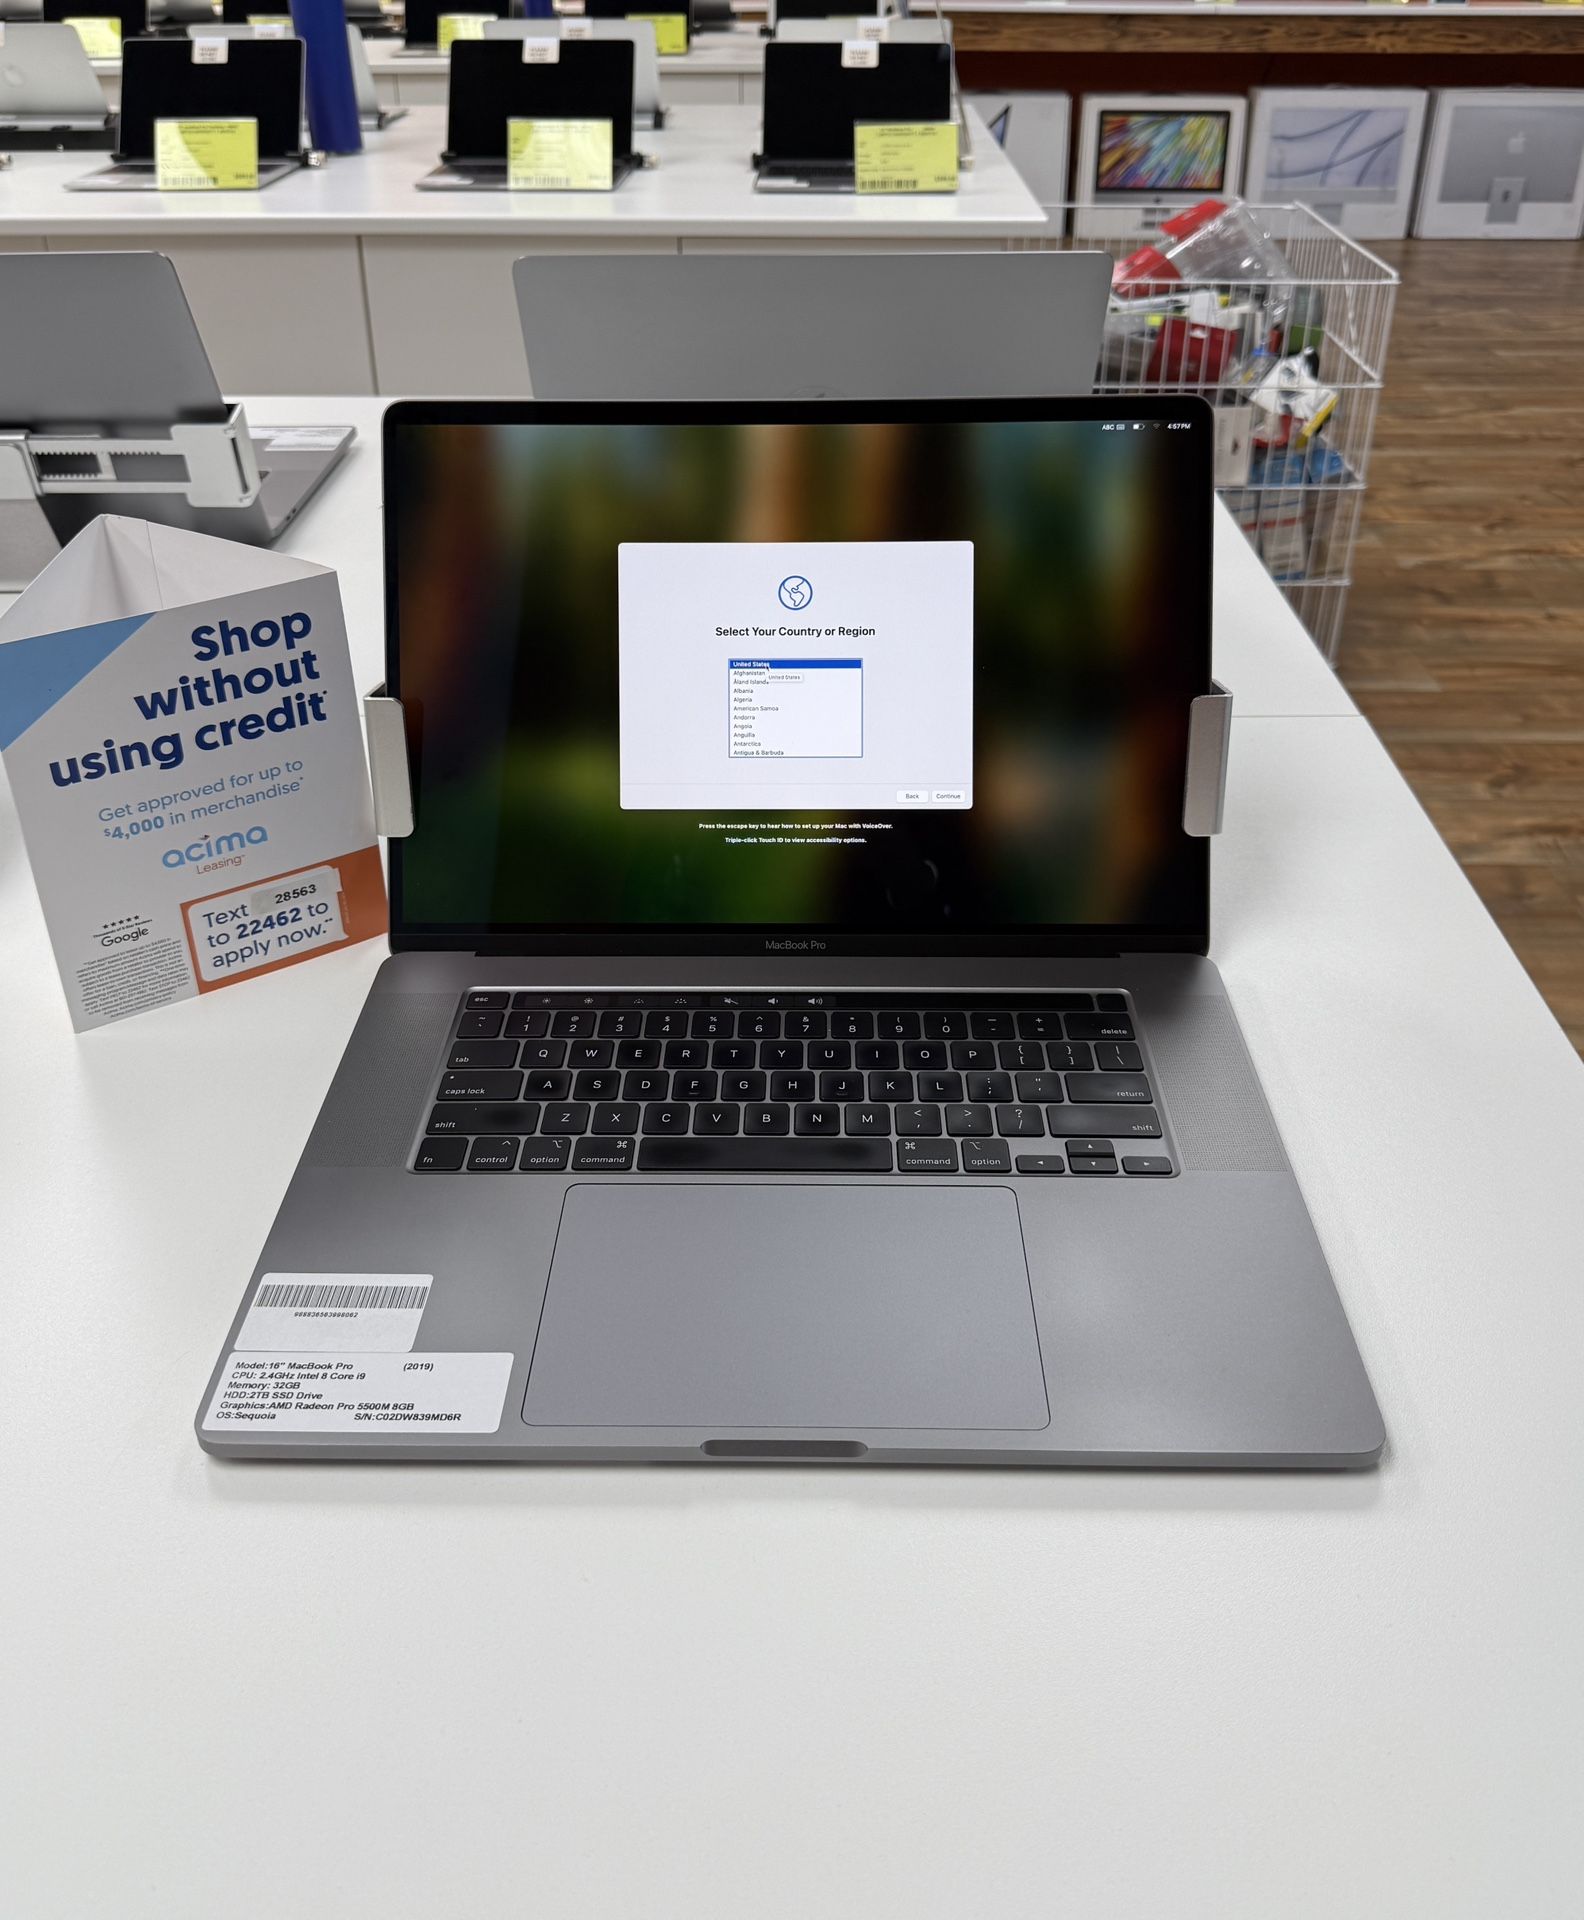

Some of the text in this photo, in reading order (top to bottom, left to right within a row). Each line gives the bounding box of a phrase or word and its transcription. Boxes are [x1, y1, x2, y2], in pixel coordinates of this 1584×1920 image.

[191, 611, 312, 661] Shop
[716, 627, 749, 636] Select
[752, 627, 776, 636] Your
[778, 627, 822, 637] Country
[838, 626, 876, 637] Region
[734, 669, 766, 677] Afghanistan
[133, 650, 320, 721] without
[734, 723, 753, 731] Angola
[734, 732, 756, 740] Anguilla
[49, 733, 184, 787] using
[98, 761, 303, 822] Get approved for up to
[104, 815, 165, 840] $4,000
[169, 811, 186, 826] in
[162, 825, 269, 869] acima
[203, 884, 316, 928] Text 28563
[208, 903, 328, 947] to 22462 to
[101, 928, 149, 946] Google
[766, 940, 826, 950] MacBook Pro
[213, 939, 270, 967] apply
[523, 1024, 530, 1032] 1
[569, 1024, 577, 1032] 2
[615, 1024, 623, 1032] 3
[662, 1024, 670, 1032] 4
[708, 1024, 717, 1032] 5
[755, 1024, 763, 1033] 6
[802, 1024, 810, 1033] 7
[848, 1025, 856, 1033] 8
[895, 1025, 903, 1033] 9
[538, 1049, 548, 1058] Q
[585, 1049, 598, 1057] W
[635, 1049, 642, 1057] E
[682, 1049, 690, 1058] R
[730, 1049, 738, 1058] T
[777, 1050, 786, 1058] Y
[825, 1050, 834, 1058] U
[968, 1050, 977, 1059] P
[467, 1087, 485, 1095] lock
[543, 1080, 553, 1089] A
[593, 1080, 601, 1089] S
[641, 1080, 650, 1089] D
[691, 1081, 699, 1089] F
[739, 1081, 749, 1090] G
[788, 1081, 798, 1090] H
[838, 1081, 846, 1090] J
[886, 1081, 895, 1090] K
[935, 1081, 944, 1090] L
[434, 1121, 456, 1129] shift
[561, 1113, 570, 1122] Z
[611, 1113, 621, 1122] X
[661, 1113, 671, 1123] C
[712, 1114, 722, 1123] V
[762, 1114, 771, 1123] B
[812, 1114, 822, 1123] N
[862, 1114, 873, 1123] M
[1015, 1108, 1023, 1118] ?
[423, 1156, 433, 1164] fn
[475, 1156, 508, 1164] control
[530, 1156, 560, 1164] option
[580, 1156, 625, 1164] command
[971, 1158, 1001, 1166] option
[287, 1361, 334, 1370] MacBook
[336, 1362, 354, 1370] Pro
[403, 1362, 434, 1372] (2019)
[231, 1371, 366, 1380] CPU: 2.4GHz Intel 8 Core i9
[227, 1381, 300, 1392] Memory: 32GB
[223, 1391, 323, 1400] HDD:2TB SSD Drive
[220, 1401, 414, 1412] Graphics:AMD Radeon Pro 5500M 8GB
[215, 1411, 461, 1421] OS:Sequoia S/N:C02DW839MD6R
